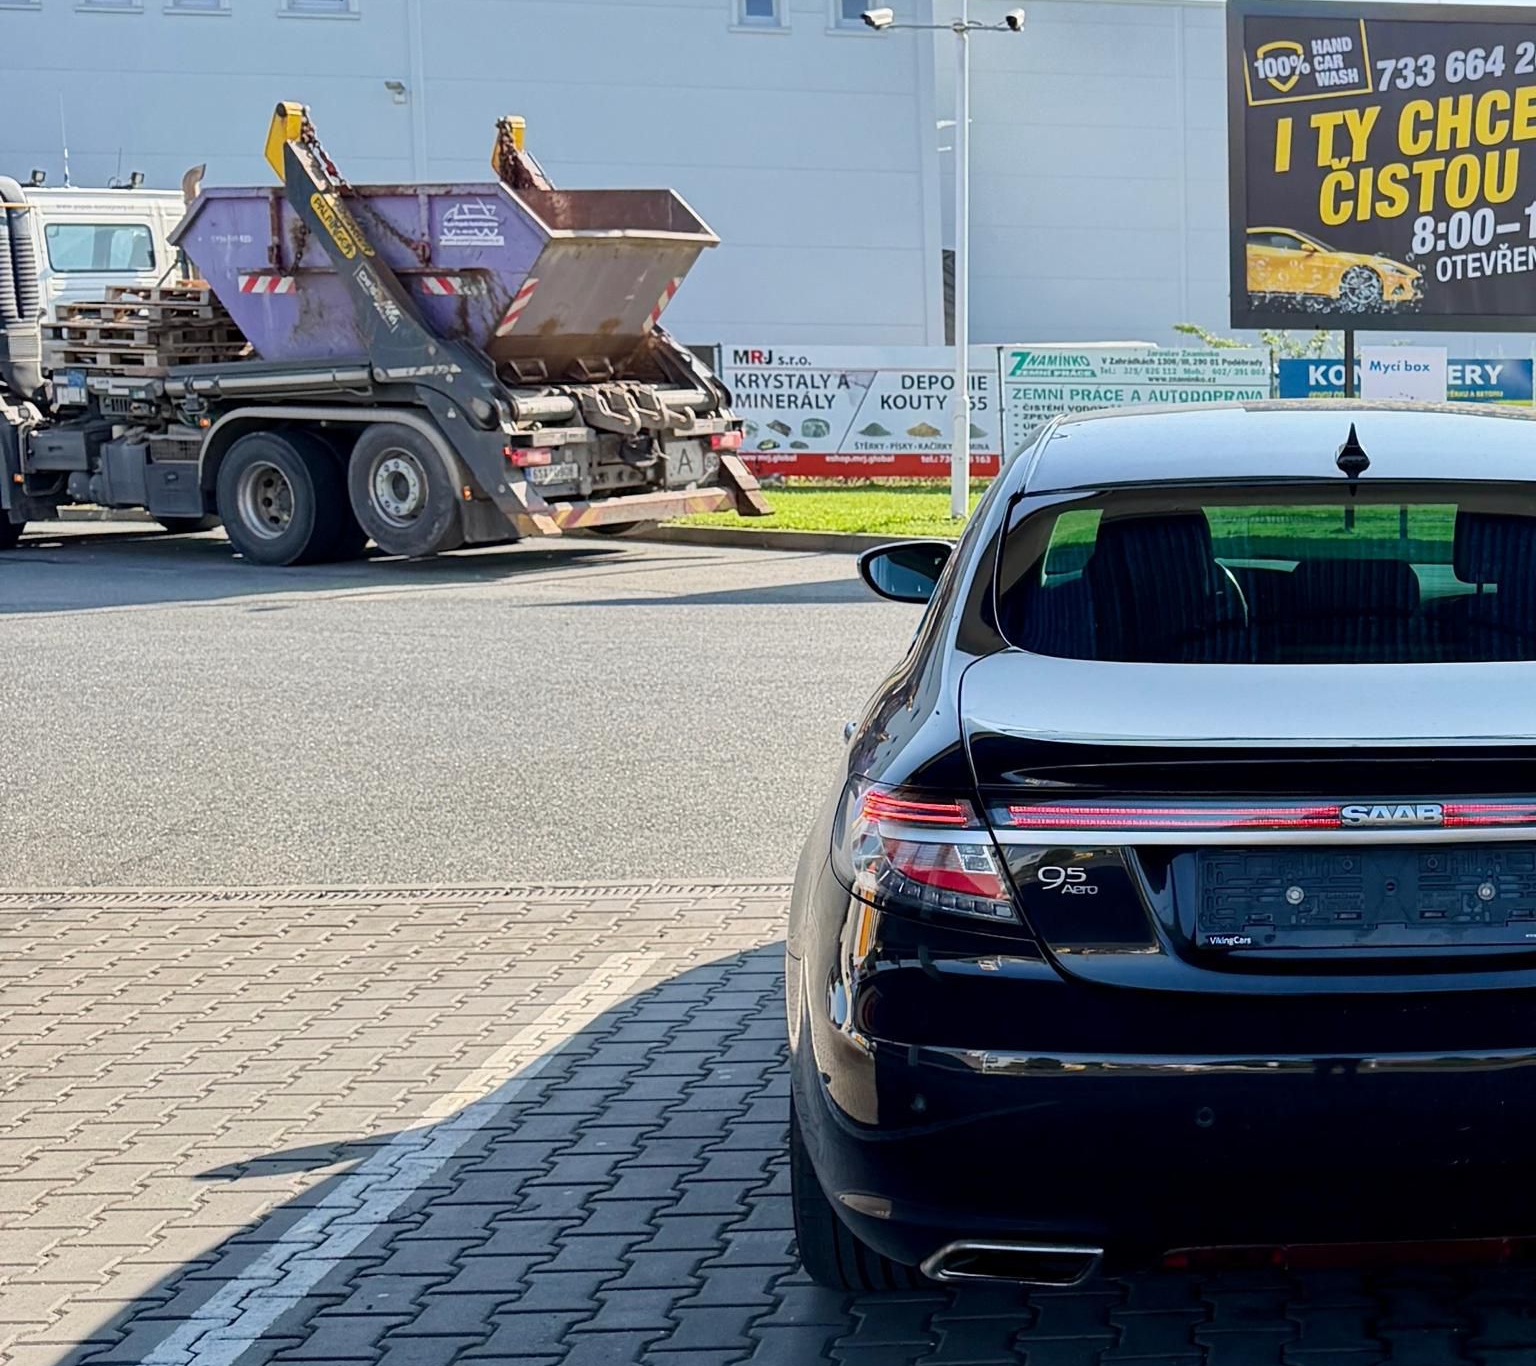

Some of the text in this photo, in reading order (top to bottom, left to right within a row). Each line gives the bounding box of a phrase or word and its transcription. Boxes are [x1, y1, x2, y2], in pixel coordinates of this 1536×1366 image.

[1311, 36, 1353, 55] HAND
[1254, 53, 1311, 80] 100%
[1313, 53, 1344, 72] CAR
[1376, 54, 1436, 92] 733
[1445, 45, 1506, 84] 664
[1315, 67, 1360, 87] WASH
[1274, 117, 1294, 173] I
[1309, 106, 1382, 168] TY
[1319, 147, 1520, 226] ČISTOU
[777, 354, 812, 367] s.r.o.
[1369, 360, 1430, 376] Mycí box
[734, 373, 851, 390] KRYSTALY A
[901, 374, 988, 391] DEPOIE
[734, 392, 836, 410] MINERÁLY
[880, 394, 948, 411] KOUTY
[1012, 385, 1065, 401] ZEMNÍ
[1070, 385, 1124, 402] PRÁCE
[1130, 388, 1141, 402] A
[677, 448, 693, 475] A
[1341, 804, 1443, 825] SAAB
[1061, 884, 1099, 895] Aero
[1209, 936, 1251, 947] VikingCars
